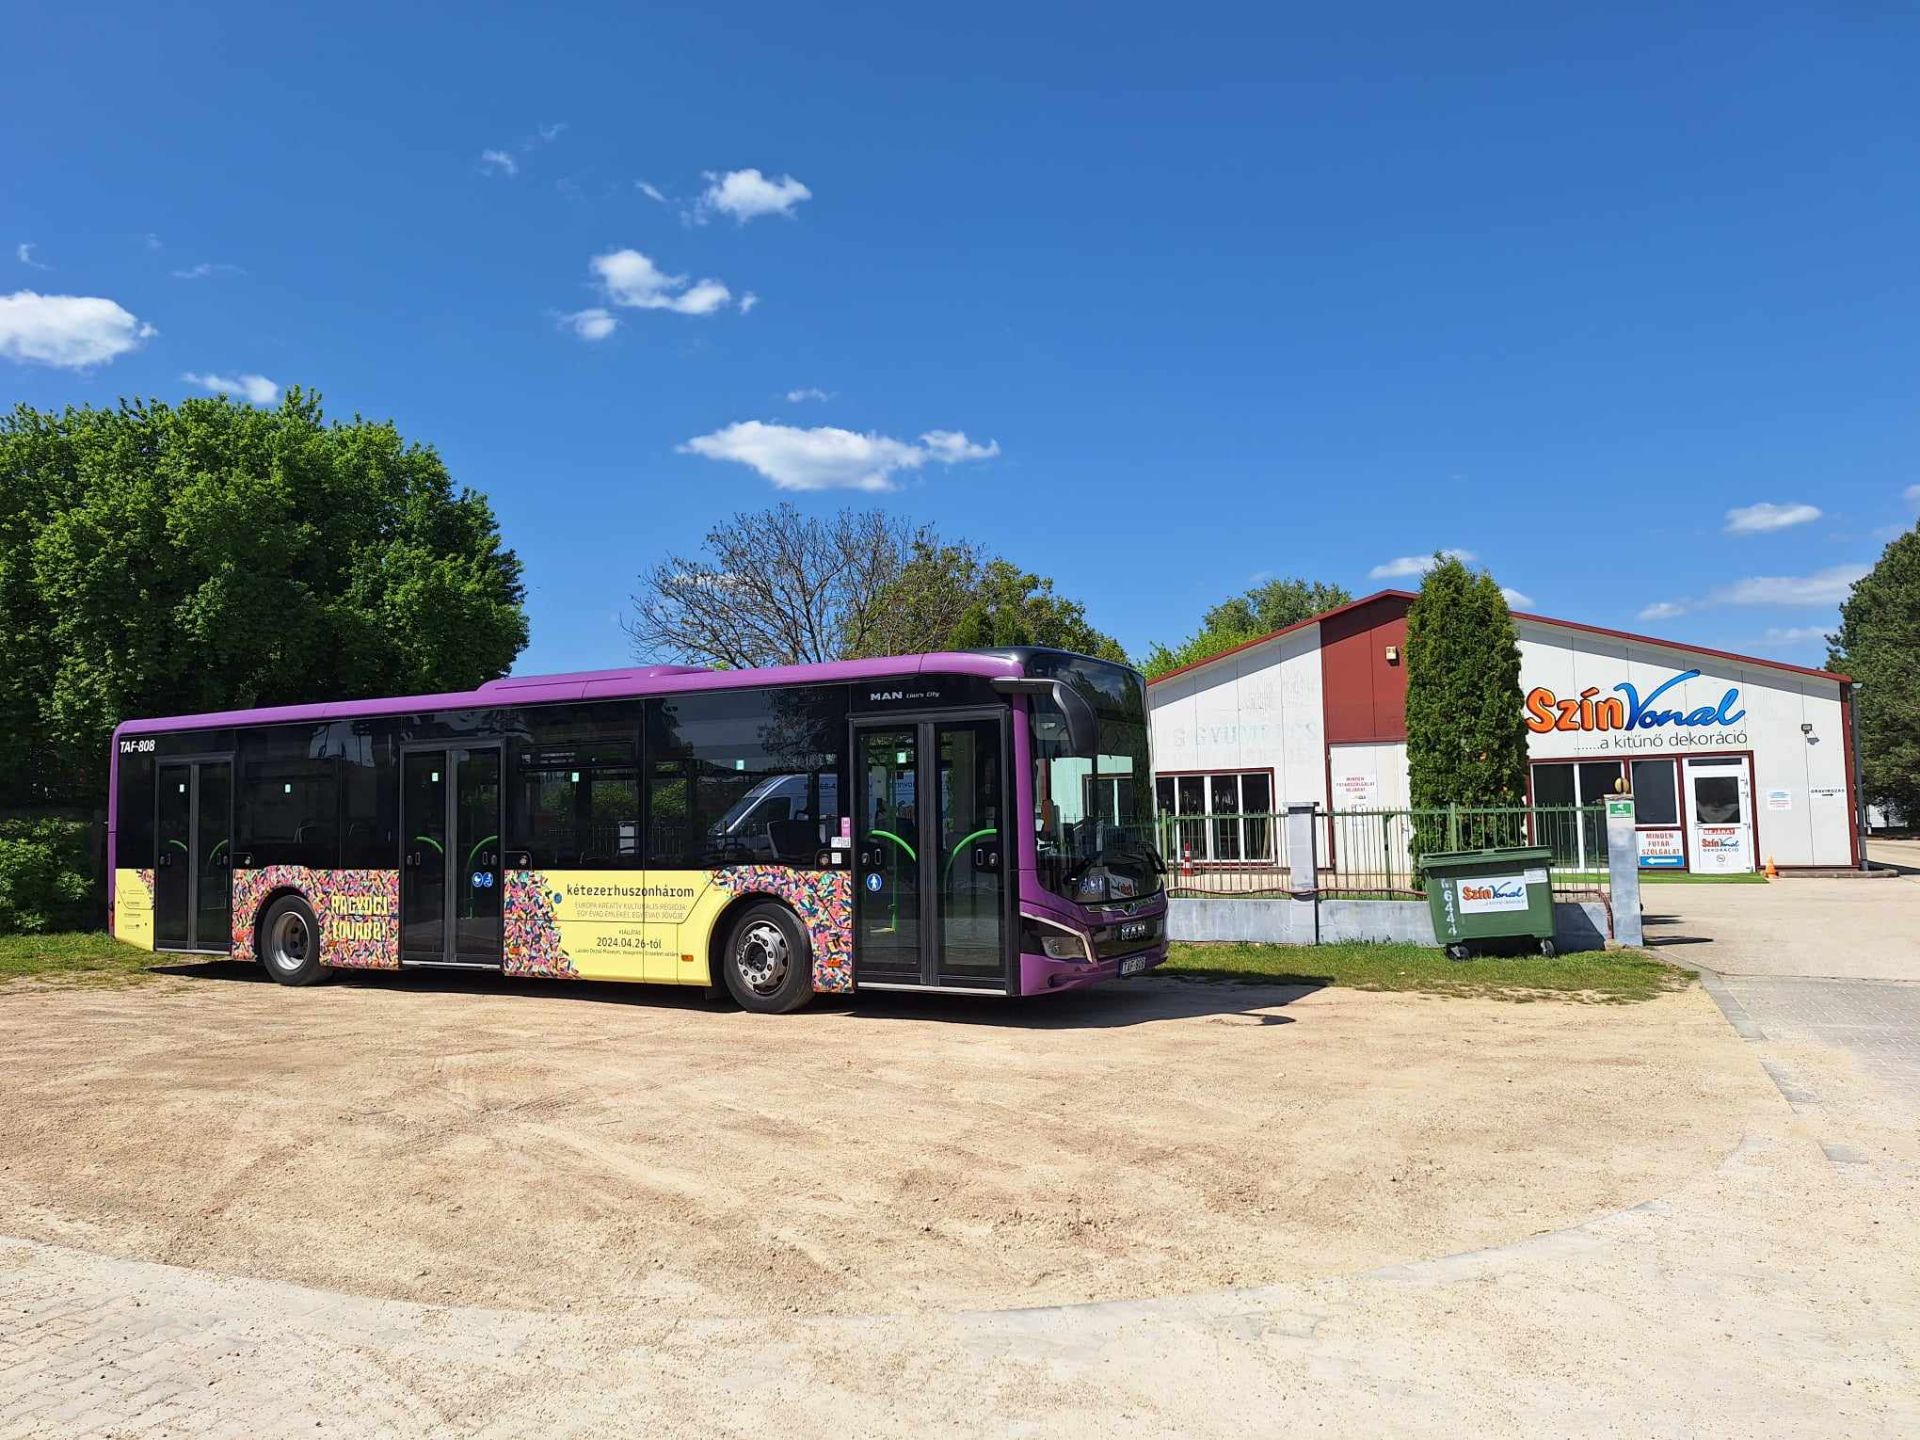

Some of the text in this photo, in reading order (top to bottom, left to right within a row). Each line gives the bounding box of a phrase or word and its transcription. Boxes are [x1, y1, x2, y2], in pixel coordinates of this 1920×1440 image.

[870, 691, 903, 701] MAN
[120, 739, 156, 754] TAF-808
[1614, 734, 1663, 750] kitűnő
[1668, 731, 1748, 747] dekoráció
[566, 883, 694, 898] kétezerhuszonhárom
[596, 936, 662, 949] 2024.04.26-tól
